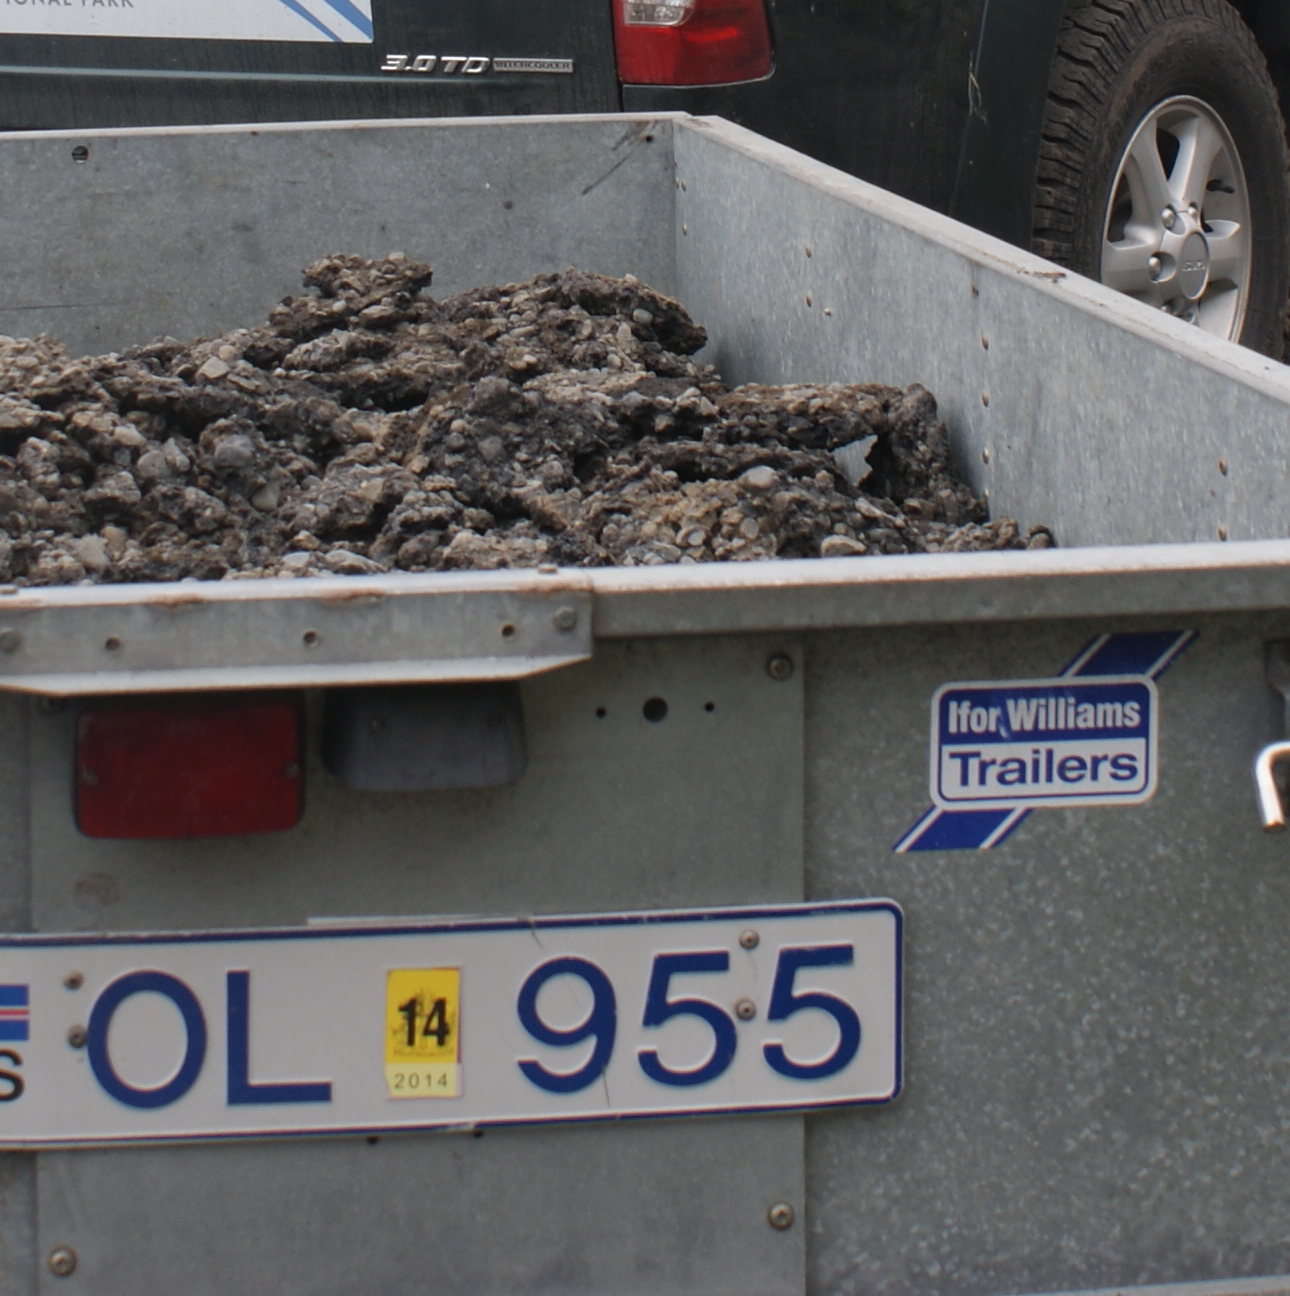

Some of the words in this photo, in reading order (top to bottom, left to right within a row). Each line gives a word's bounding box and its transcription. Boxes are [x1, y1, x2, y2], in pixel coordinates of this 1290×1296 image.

[380, 54, 437, 72] 3.0
[440, 56, 491, 74] TD
[947, 699, 1001, 734] Ifor
[1006, 696, 1142, 733] Williams
[948, 747, 1139, 788] Trailers
[86, 968, 333, 1110] OL
[516, 943, 862, 1094] 955
[397, 995, 450, 1049] 14
[393, 1071, 449, 1090] 2014
